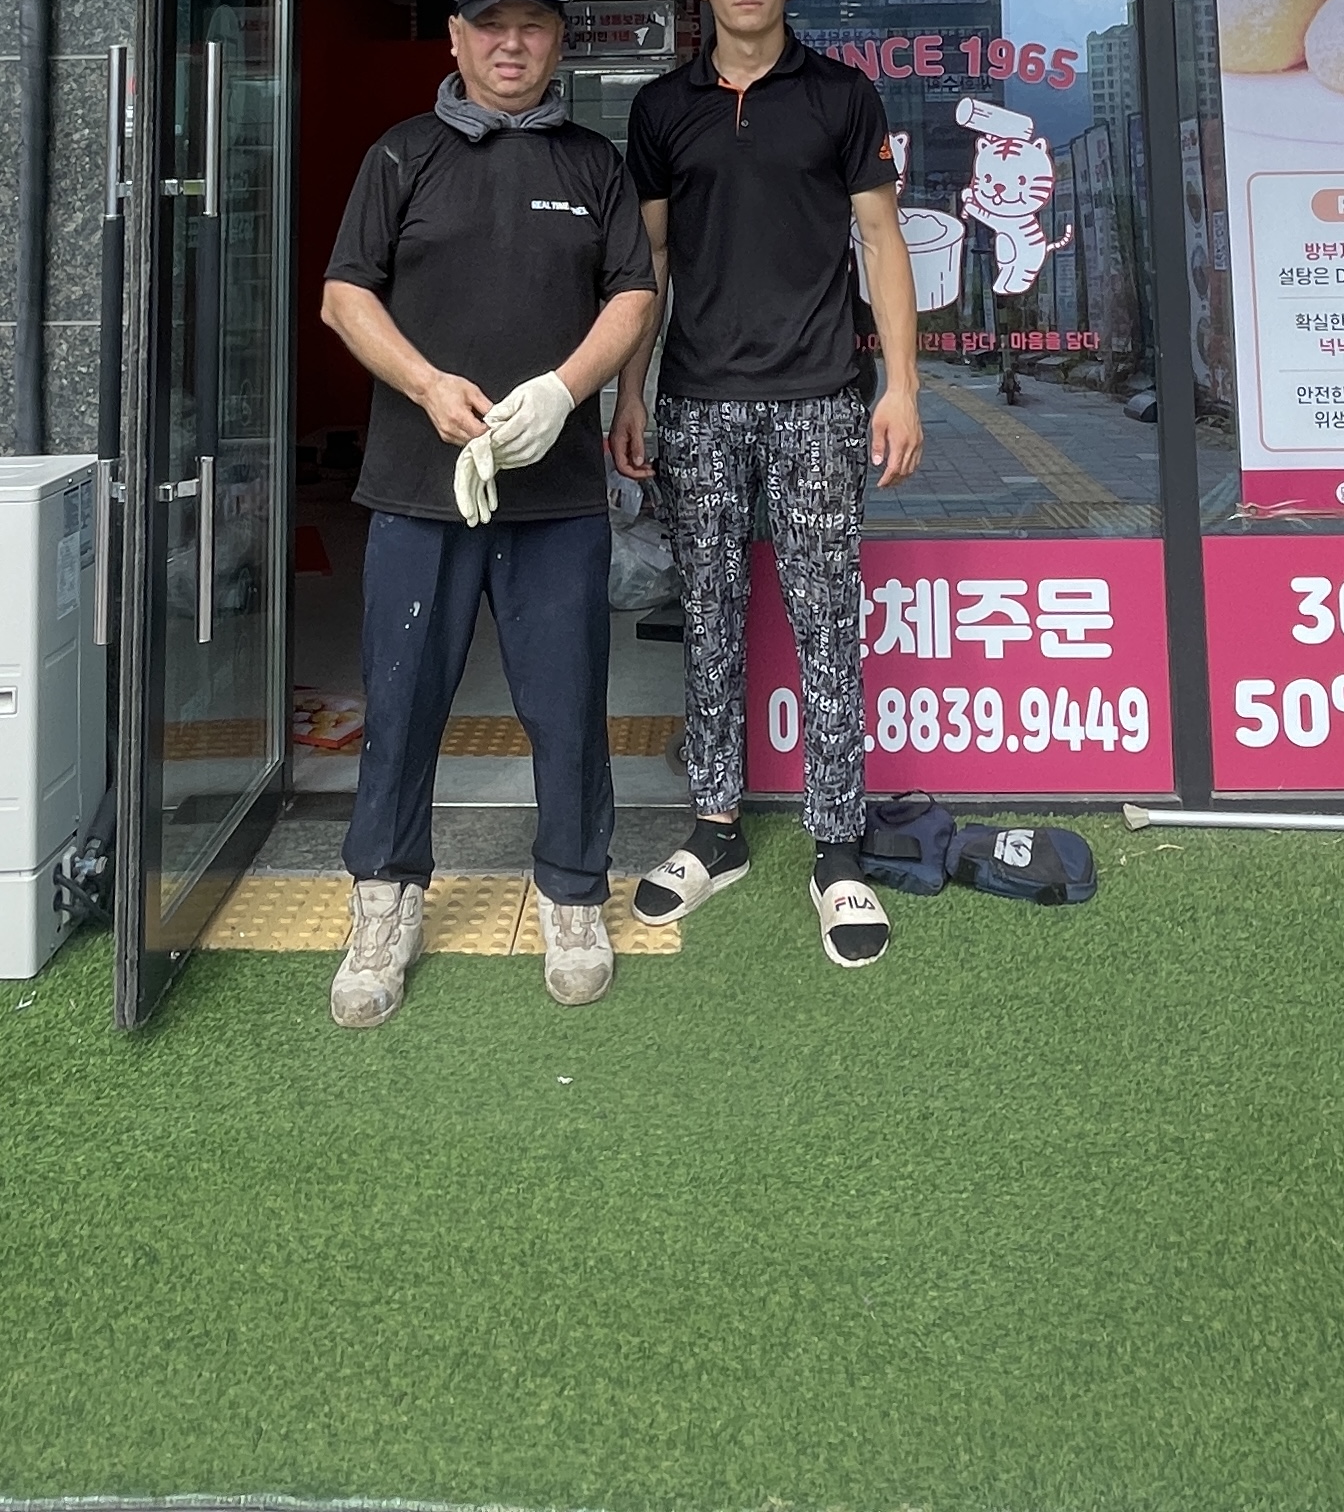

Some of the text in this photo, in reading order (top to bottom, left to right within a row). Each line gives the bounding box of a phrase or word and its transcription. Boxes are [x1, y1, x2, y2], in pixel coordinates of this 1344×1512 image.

[959, 35, 1079, 90] 1965
[1278, 266, 1330, 287] 설탕은
[1010, 331, 1061, 351] 마음을
[1065, 330, 1101, 351] 담다
[860, 576, 1115, 659] 체주문
[768, 686, 1149, 754] 0.8839.9449
[655, 860, 687, 880] FILA
[833, 895, 877, 913] FILA
